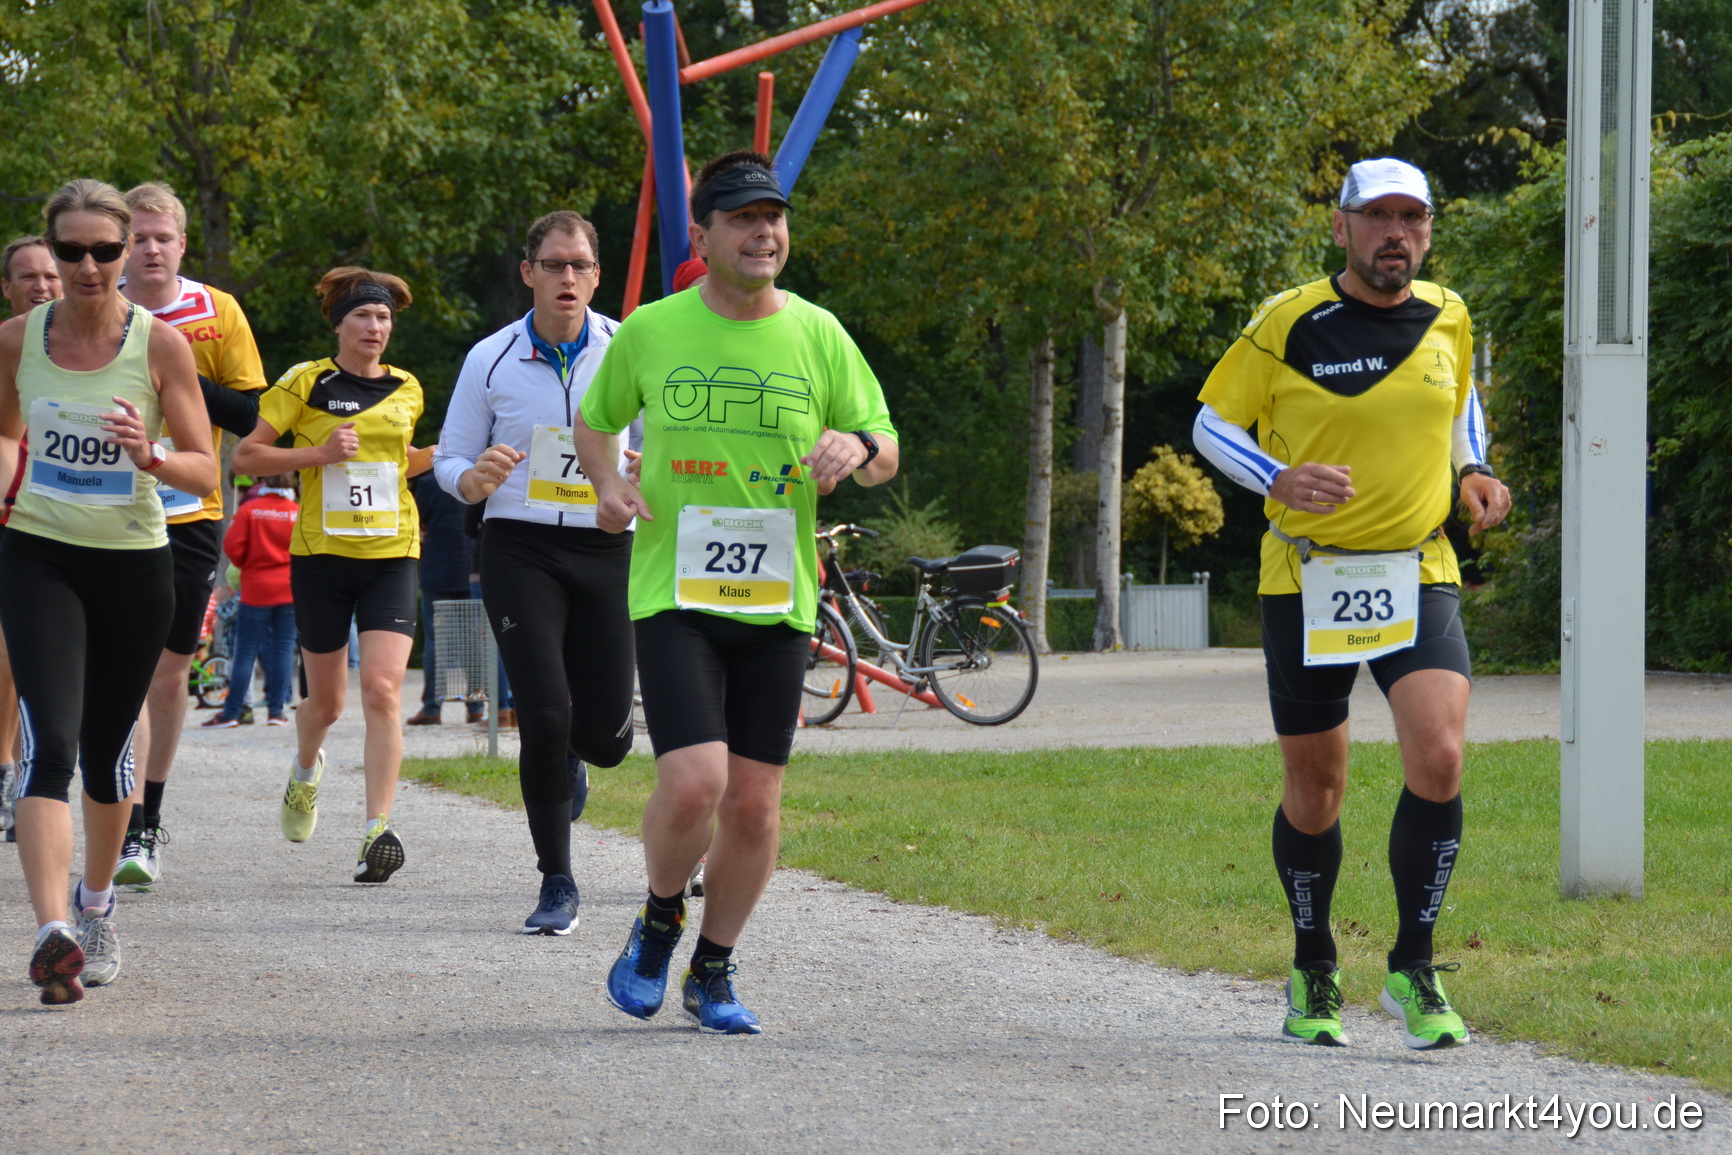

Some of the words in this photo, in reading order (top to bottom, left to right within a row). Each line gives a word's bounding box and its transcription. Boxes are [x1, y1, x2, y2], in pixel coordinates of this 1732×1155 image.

[1312, 359, 1363, 377] Bernd
[1366, 356, 1388, 371] W.
[328, 400, 360, 411] Birgit
[708, 426, 788, 440] Automatisierungstechnik
[44, 430, 121, 465] 2099
[353, 468, 378, 476] BOCK
[671, 459, 729, 476] MERZ
[57, 471, 103, 487] Manuela
[749, 470, 805, 486] Bretschneider
[349, 484, 373, 507] 51
[555, 486, 589, 498] Thomas
[352, 514, 374, 524] Birgit
[723, 518, 764, 529] BOCK
[704, 541, 768, 574] 237
[1346, 564, 1387, 575] BOCK
[719, 585, 751, 598] Klaus
[1331, 588, 1394, 622] 233
[1347, 633, 1381, 645] Bernd
